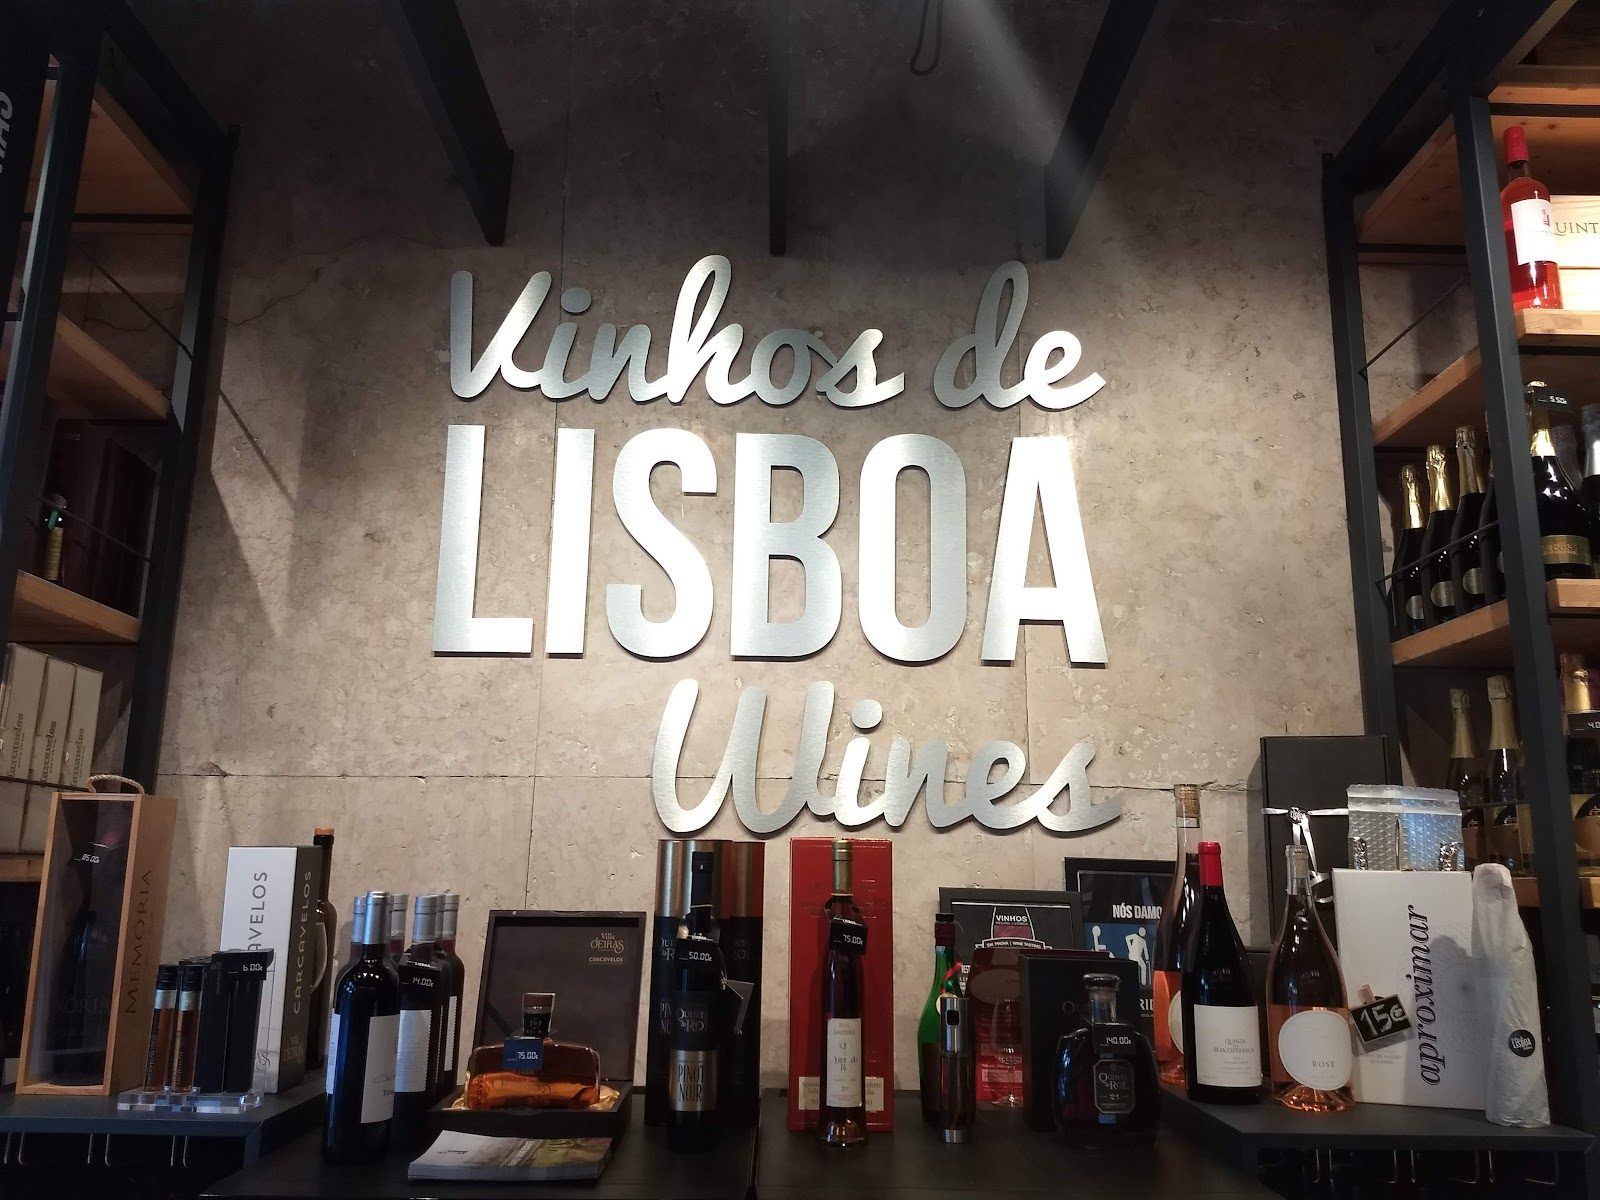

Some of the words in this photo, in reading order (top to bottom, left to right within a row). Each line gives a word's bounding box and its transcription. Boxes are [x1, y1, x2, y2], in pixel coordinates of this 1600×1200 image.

[1553, 221, 1600, 236] UINT
[449, 254, 906, 408] Vinhos
[932, 259, 1107, 409] de
[432, 424, 1109, 665] LISBOA
[651, 678, 1123, 835] Wines
[247, 871, 268, 951] AVELOS
[293, 871, 312, 1014] CARCAVELOS
[995, 914, 1028, 922] VINHOS
[1112, 902, 1133, 919] NÓS
[1134, 905, 1163, 920] DAMO
[1407, 903, 1447, 1087] aproximar
[678, 1083, 703, 1104] NOIR
